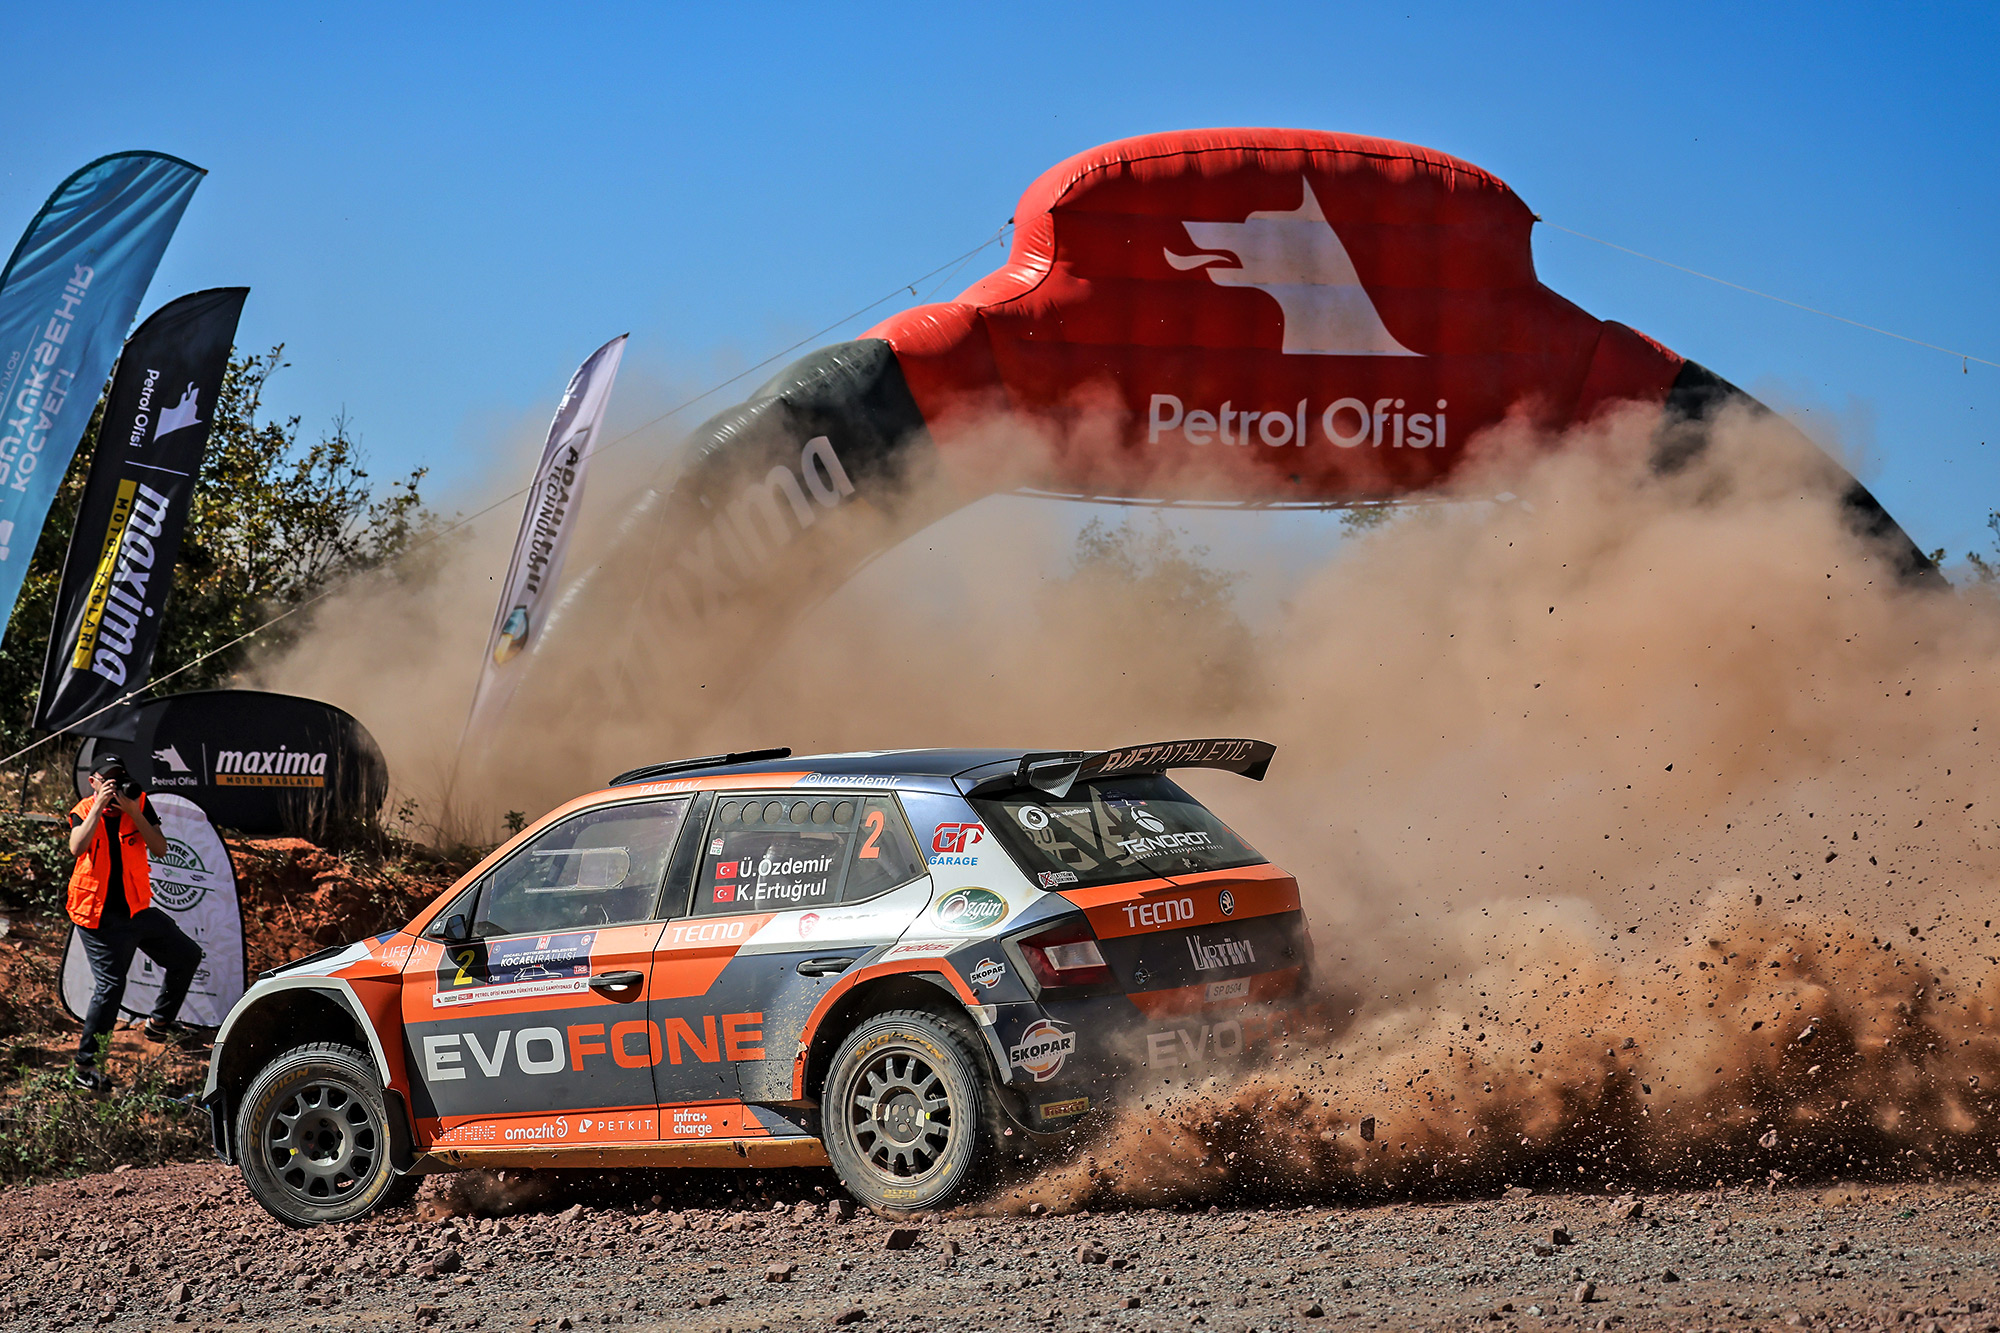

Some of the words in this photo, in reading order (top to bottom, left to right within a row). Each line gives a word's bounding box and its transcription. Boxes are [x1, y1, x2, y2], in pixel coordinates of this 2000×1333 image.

[139, 368, 160, 413] Petrol
[129, 413, 149, 447] Ofisi
[1148, 393, 1308, 448] Petrol
[1322, 396, 1448, 449] Ofisi
[101, 497, 129, 560] MOTOR
[92, 483, 170, 687] maxima
[215, 744, 328, 775] maxima
[151, 776, 176, 786] Petrol
[177, 777, 198, 786] Ofisi
[226, 776, 262, 785] MOTOR
[821, 774, 901, 788] ucozdemir
[858, 810, 885, 859] 2
[166, 843, 189, 860] VRE
[929, 856, 979, 866] GARAGE
[739, 854, 834, 879] Ü.Özdemir
[736, 878, 827, 902] K.Ertuğrul
[941, 890, 1003, 921] Özgün
[1122, 897, 1195, 928] TECNO
[672, 922, 744, 943] TECNO
[382, 944, 430, 959] LIFEON
[453, 950, 476, 986] 2
[971, 965, 1004, 982] SKOPAR
[1213, 986, 1224, 997] SP
[422, 1011, 767, 1082] EVOFONE
[1011, 1037, 1072, 1063] SKOPAR
[250, 1067, 310, 1148] SCORPION
[673, 1109, 708, 1123] infra+
[438, 1124, 497, 1143] NOTHING
[504, 1122, 556, 1141] amazfit
[673, 1122, 713, 1138] charge
